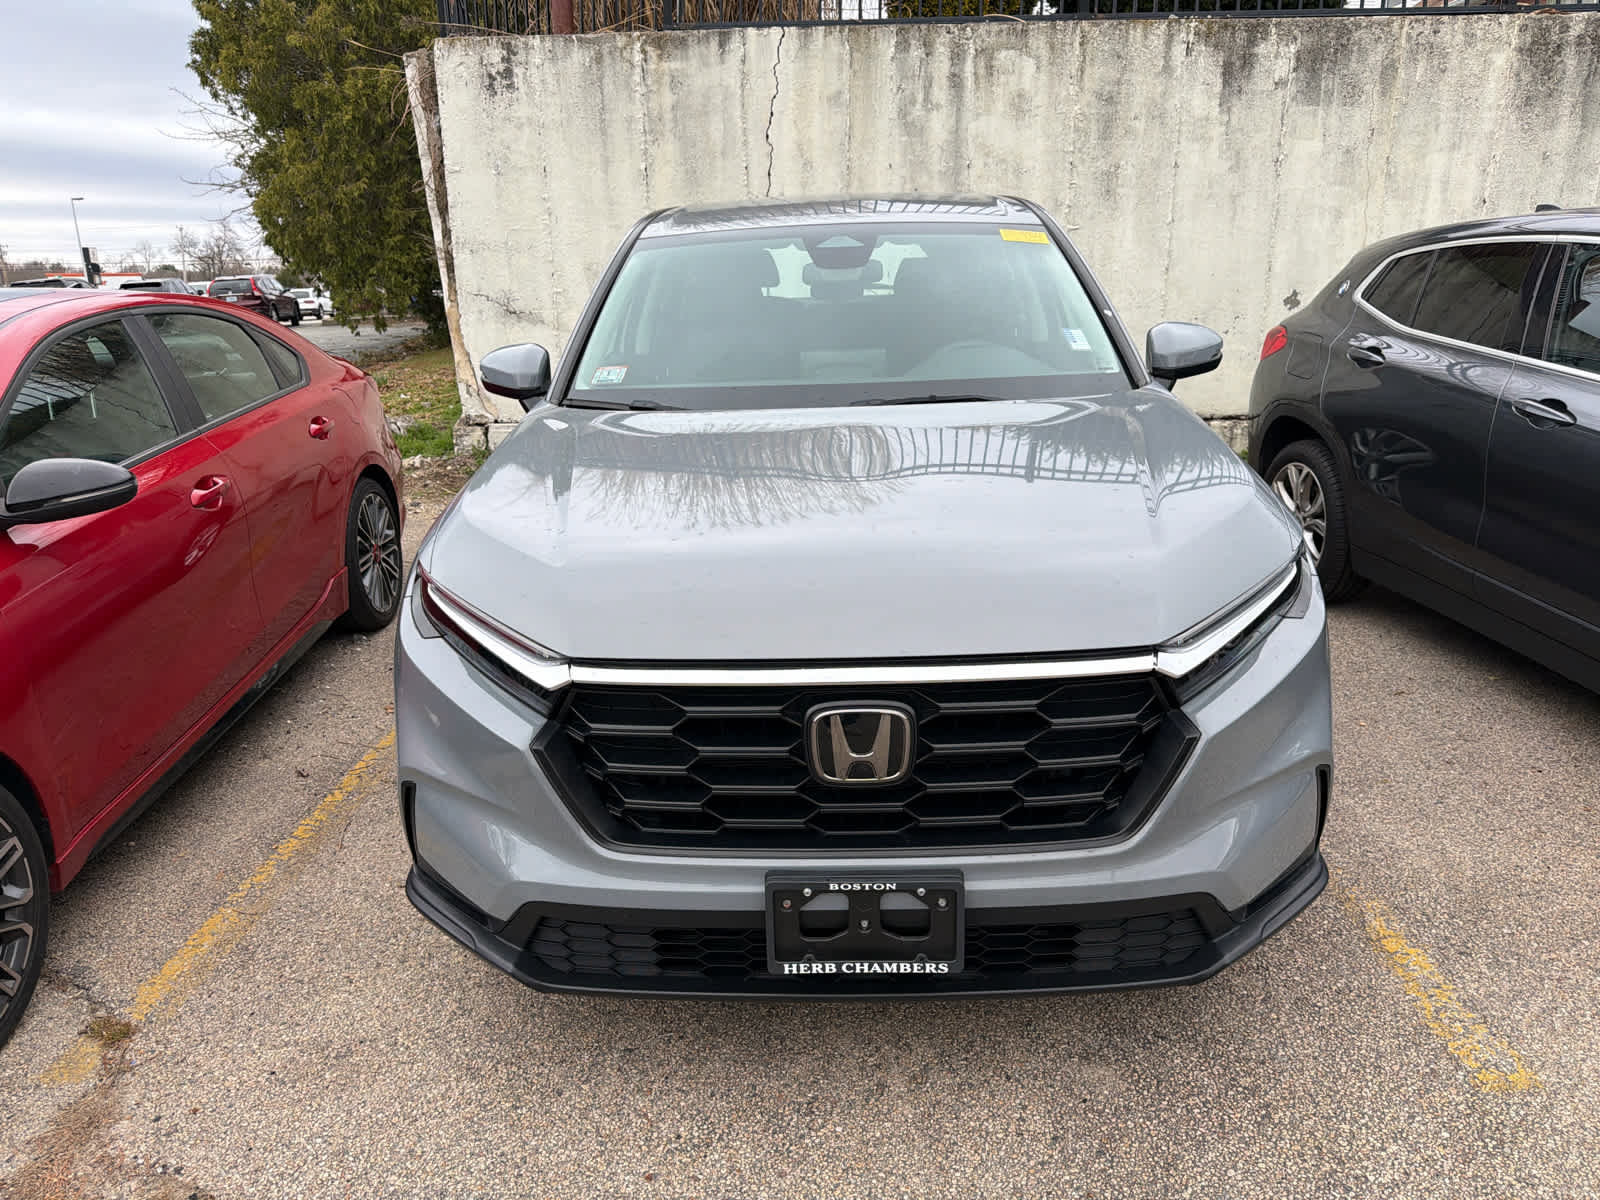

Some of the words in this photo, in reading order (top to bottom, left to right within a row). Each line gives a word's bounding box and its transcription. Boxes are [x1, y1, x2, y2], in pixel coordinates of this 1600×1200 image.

[829, 883, 897, 891] BOSTON
[783, 963, 837, 975] HERB
[841, 962, 949, 975] CHAMBERS
